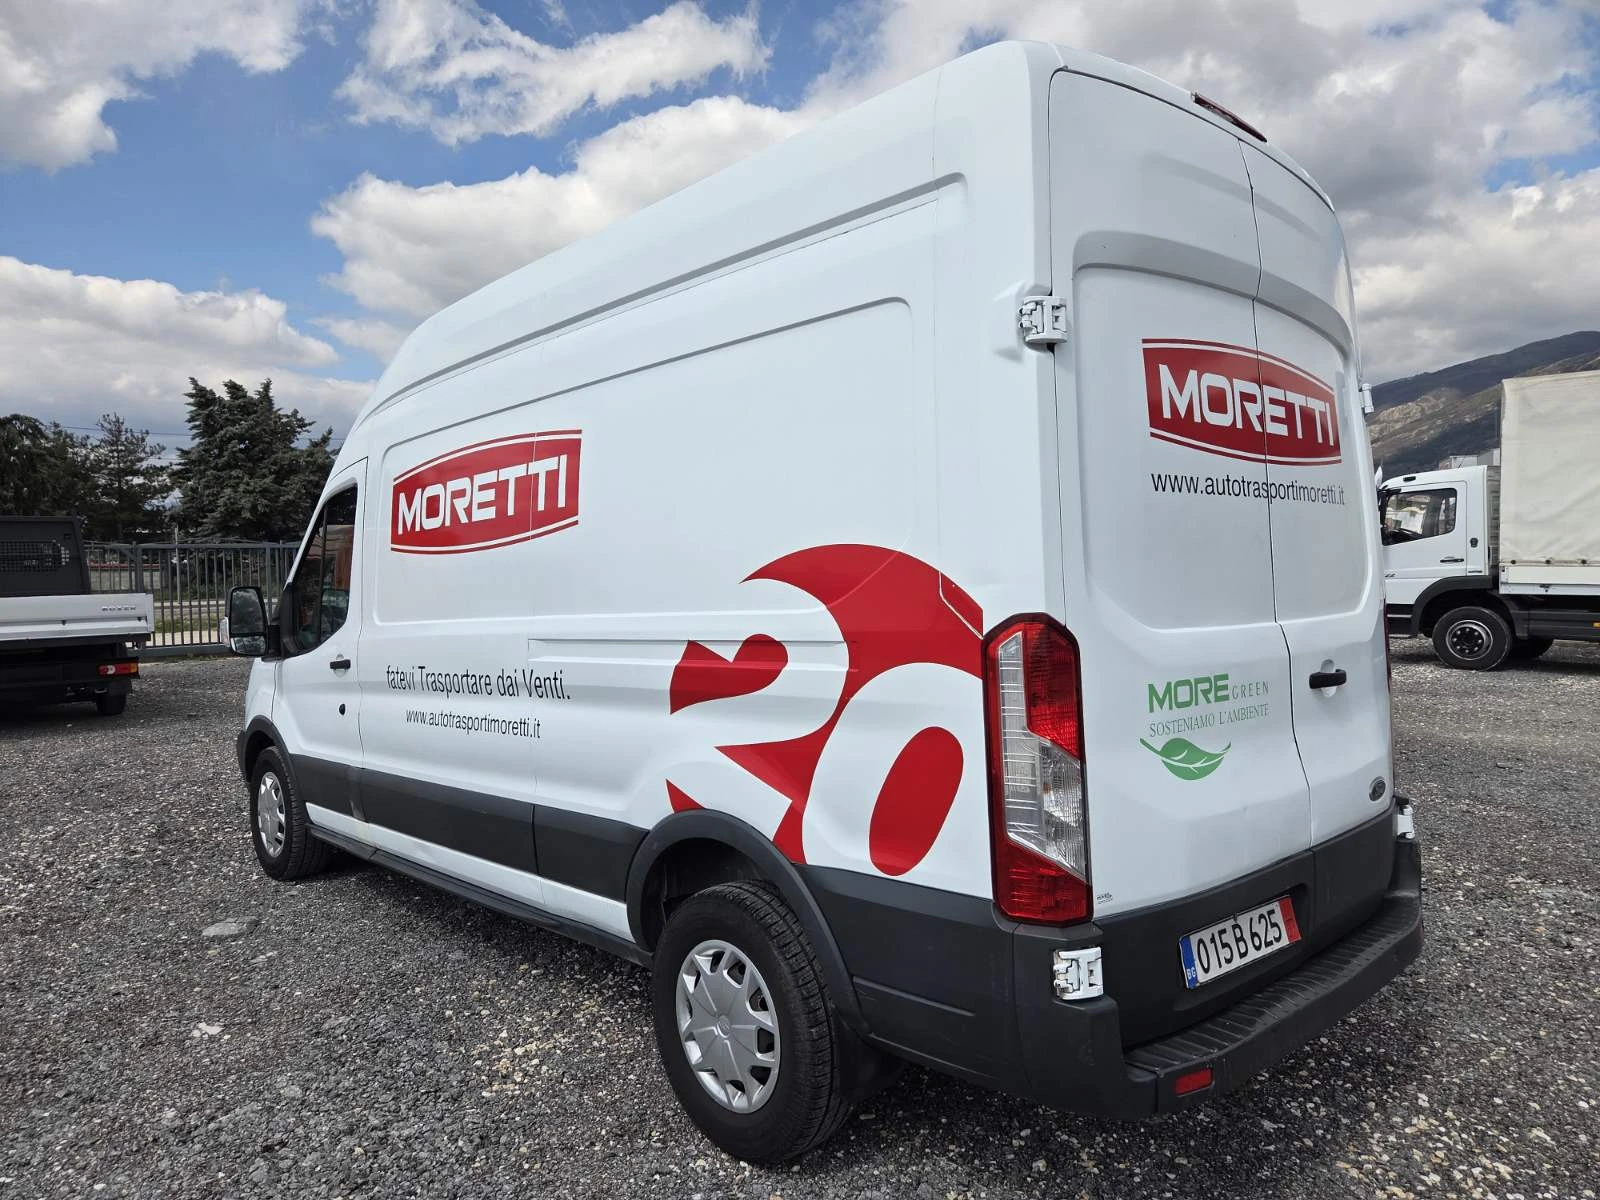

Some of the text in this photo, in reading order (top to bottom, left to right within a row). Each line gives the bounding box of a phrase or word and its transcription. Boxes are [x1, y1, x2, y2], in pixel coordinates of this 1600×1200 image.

[1158, 363, 1335, 447] MORETTI
[397, 454, 568, 536] MORETTI
[1151, 473, 1345, 505] www.autotrasportimoretti.it
[386, 665, 571, 700] fatevi Trasportare dai Venti.
[1148, 673, 1269, 712] MORE GREEN
[406, 709, 540, 738] www.autotrasportimoretti.it
[1150, 703, 1268, 737] SOSTENIAMO L'AMBIENTE
[1186, 967, 1196, 979] BG
